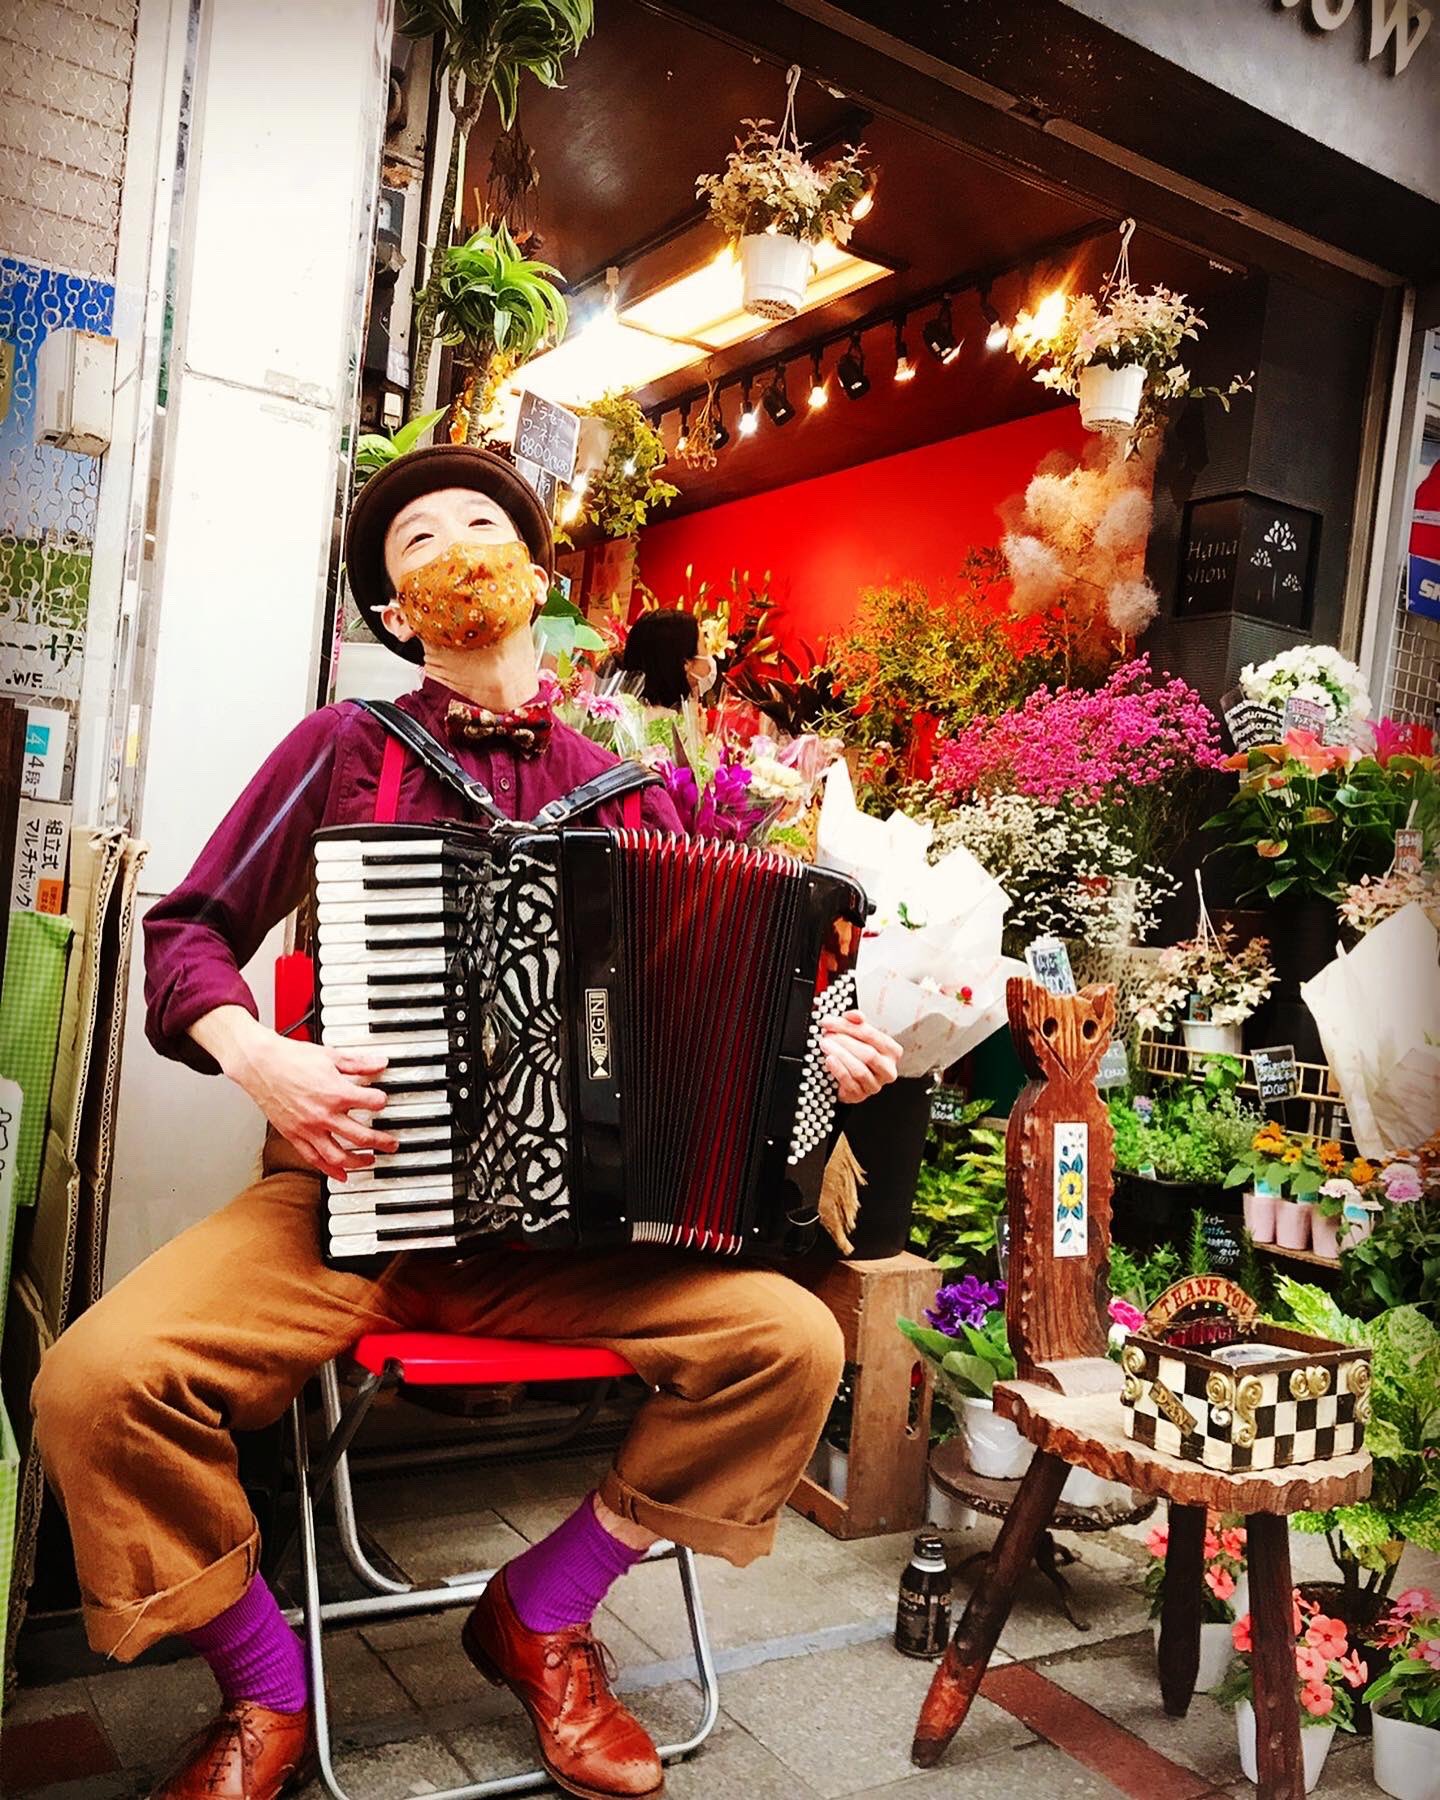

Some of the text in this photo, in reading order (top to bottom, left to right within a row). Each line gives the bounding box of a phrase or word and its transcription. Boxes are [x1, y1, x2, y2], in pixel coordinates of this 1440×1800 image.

[1186, 539, 1238, 560] Hana
[41, 818, 63, 870] 組立式
[590, 994, 607, 1047] PIGINI
[1159, 1278, 1252, 1317] THANK YOU
[1156, 1387, 1188, 1426] DAN
